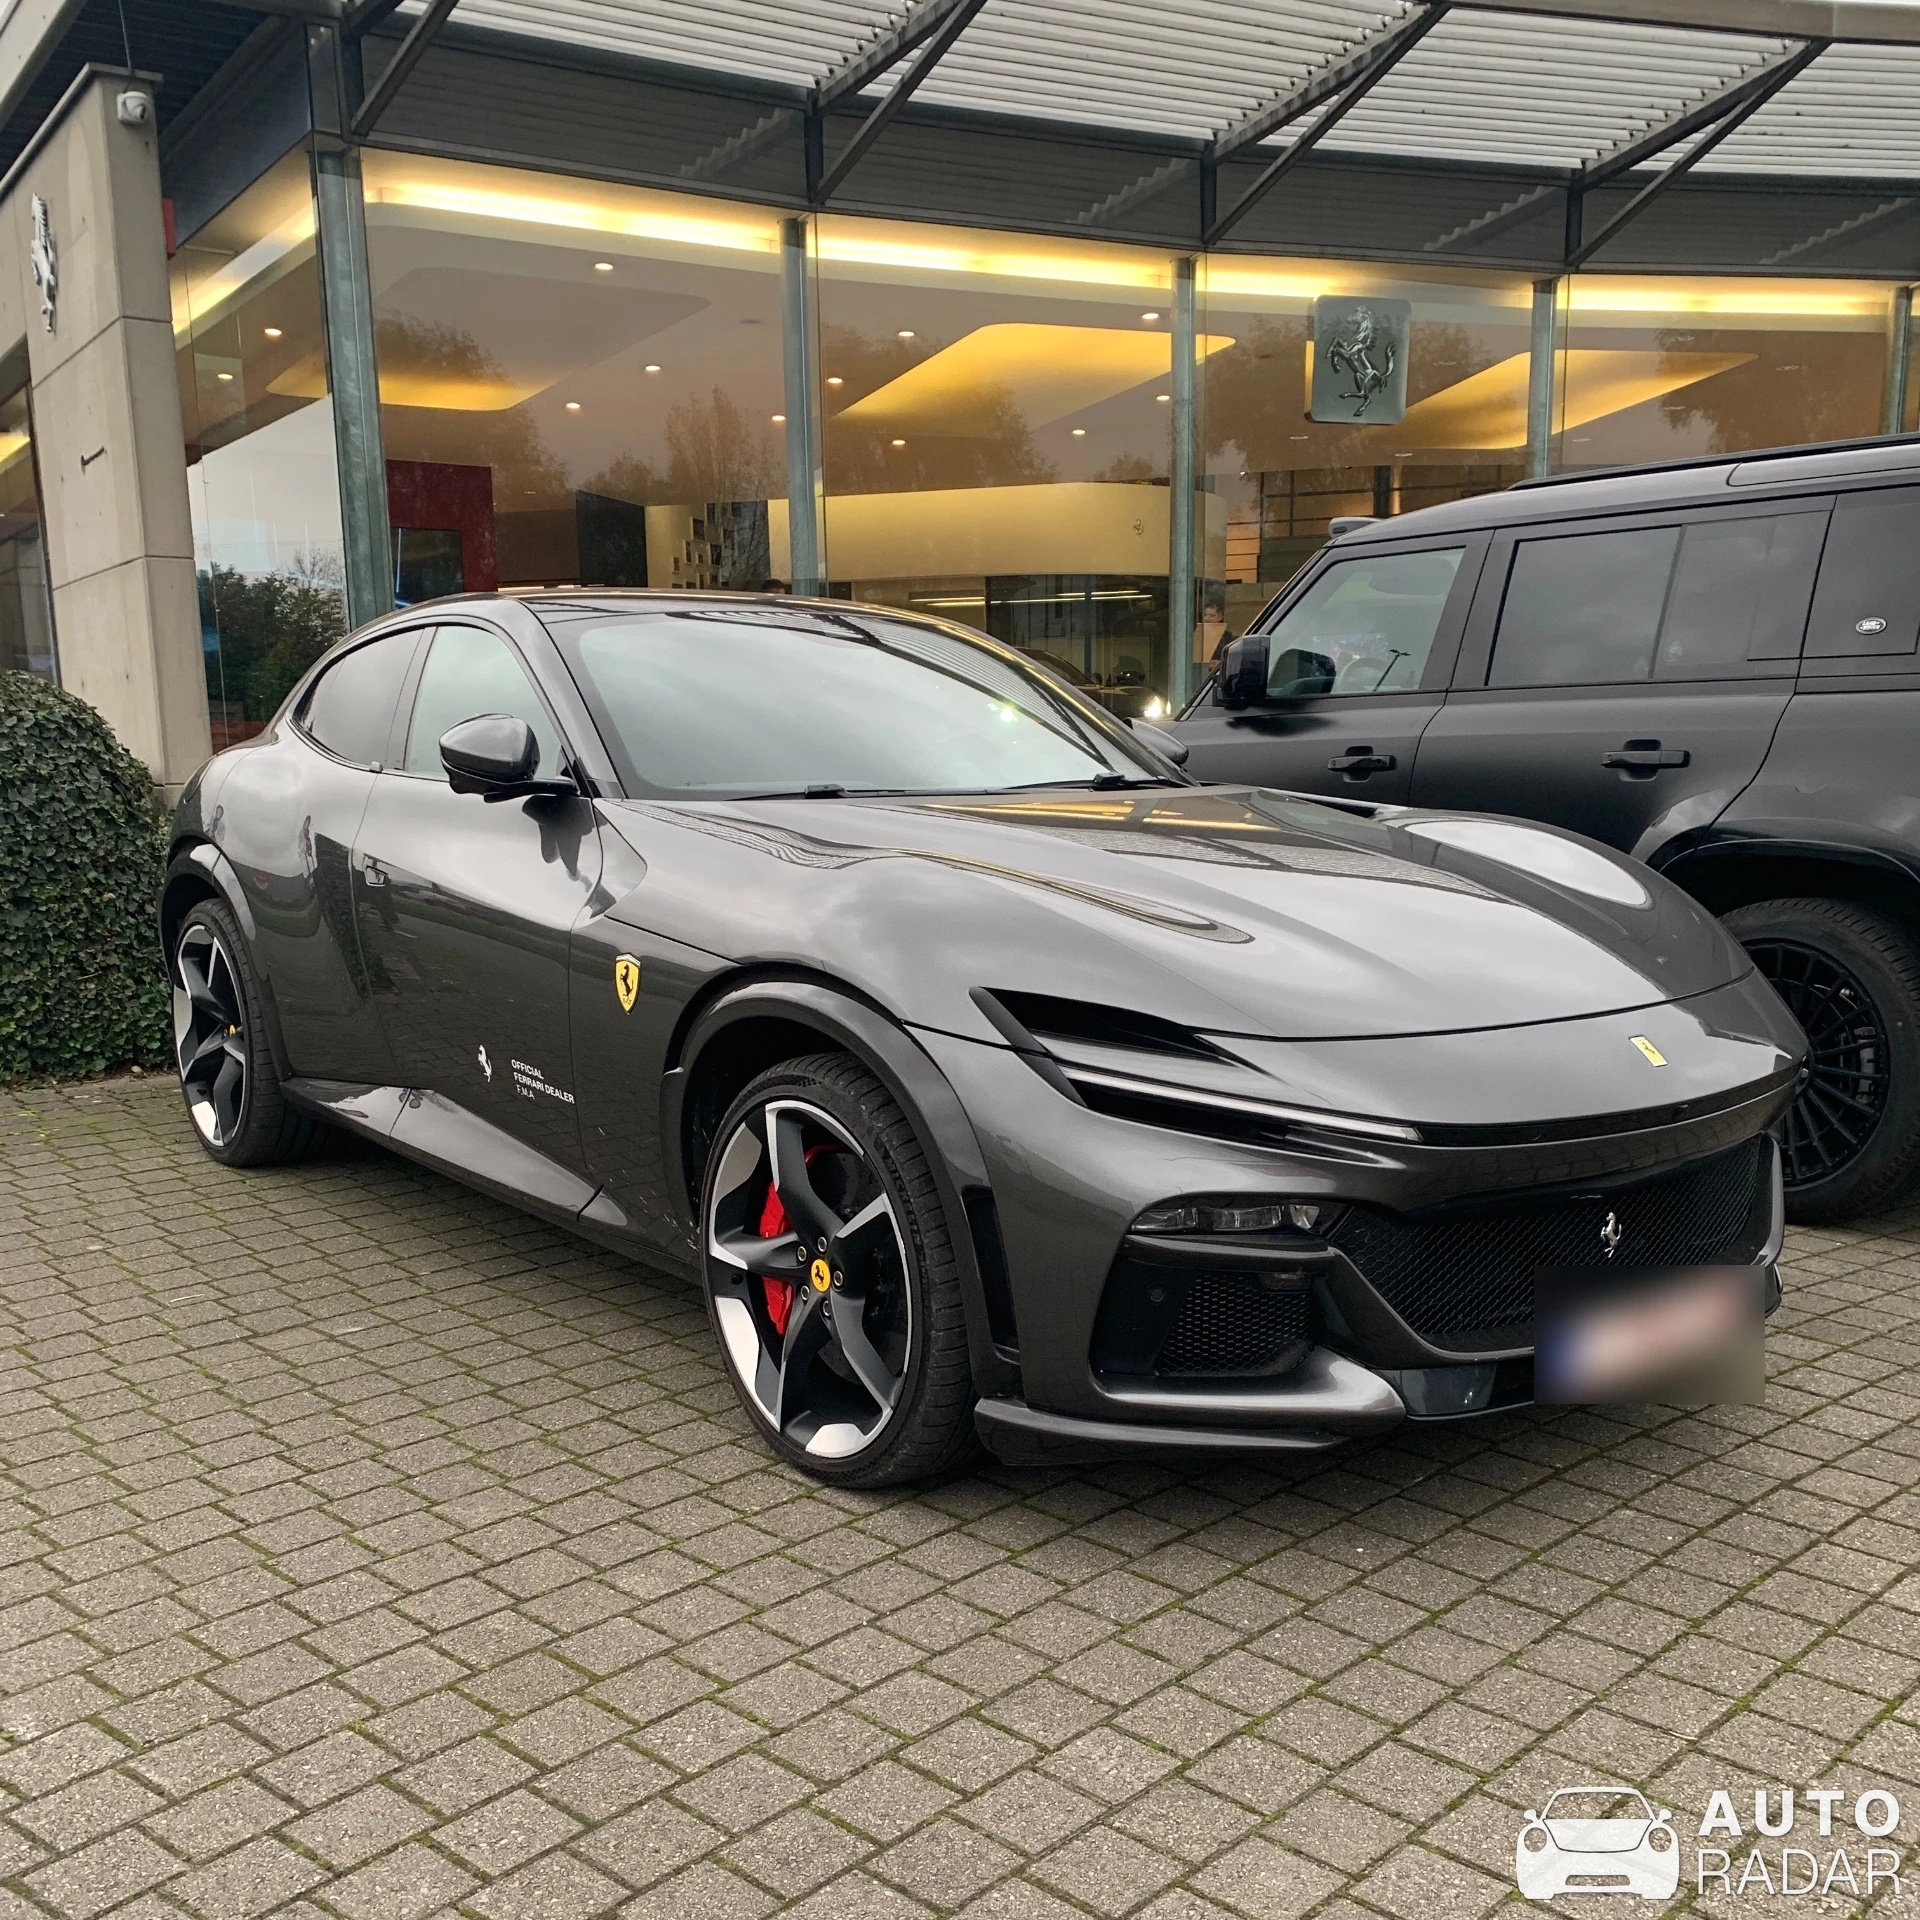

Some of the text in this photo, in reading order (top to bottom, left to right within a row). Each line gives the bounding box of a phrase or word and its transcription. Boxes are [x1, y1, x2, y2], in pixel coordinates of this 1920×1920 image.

[511, 1059, 544, 1079] OFFICIAL
[513, 1071, 575, 1104] FERRARI DEALER
